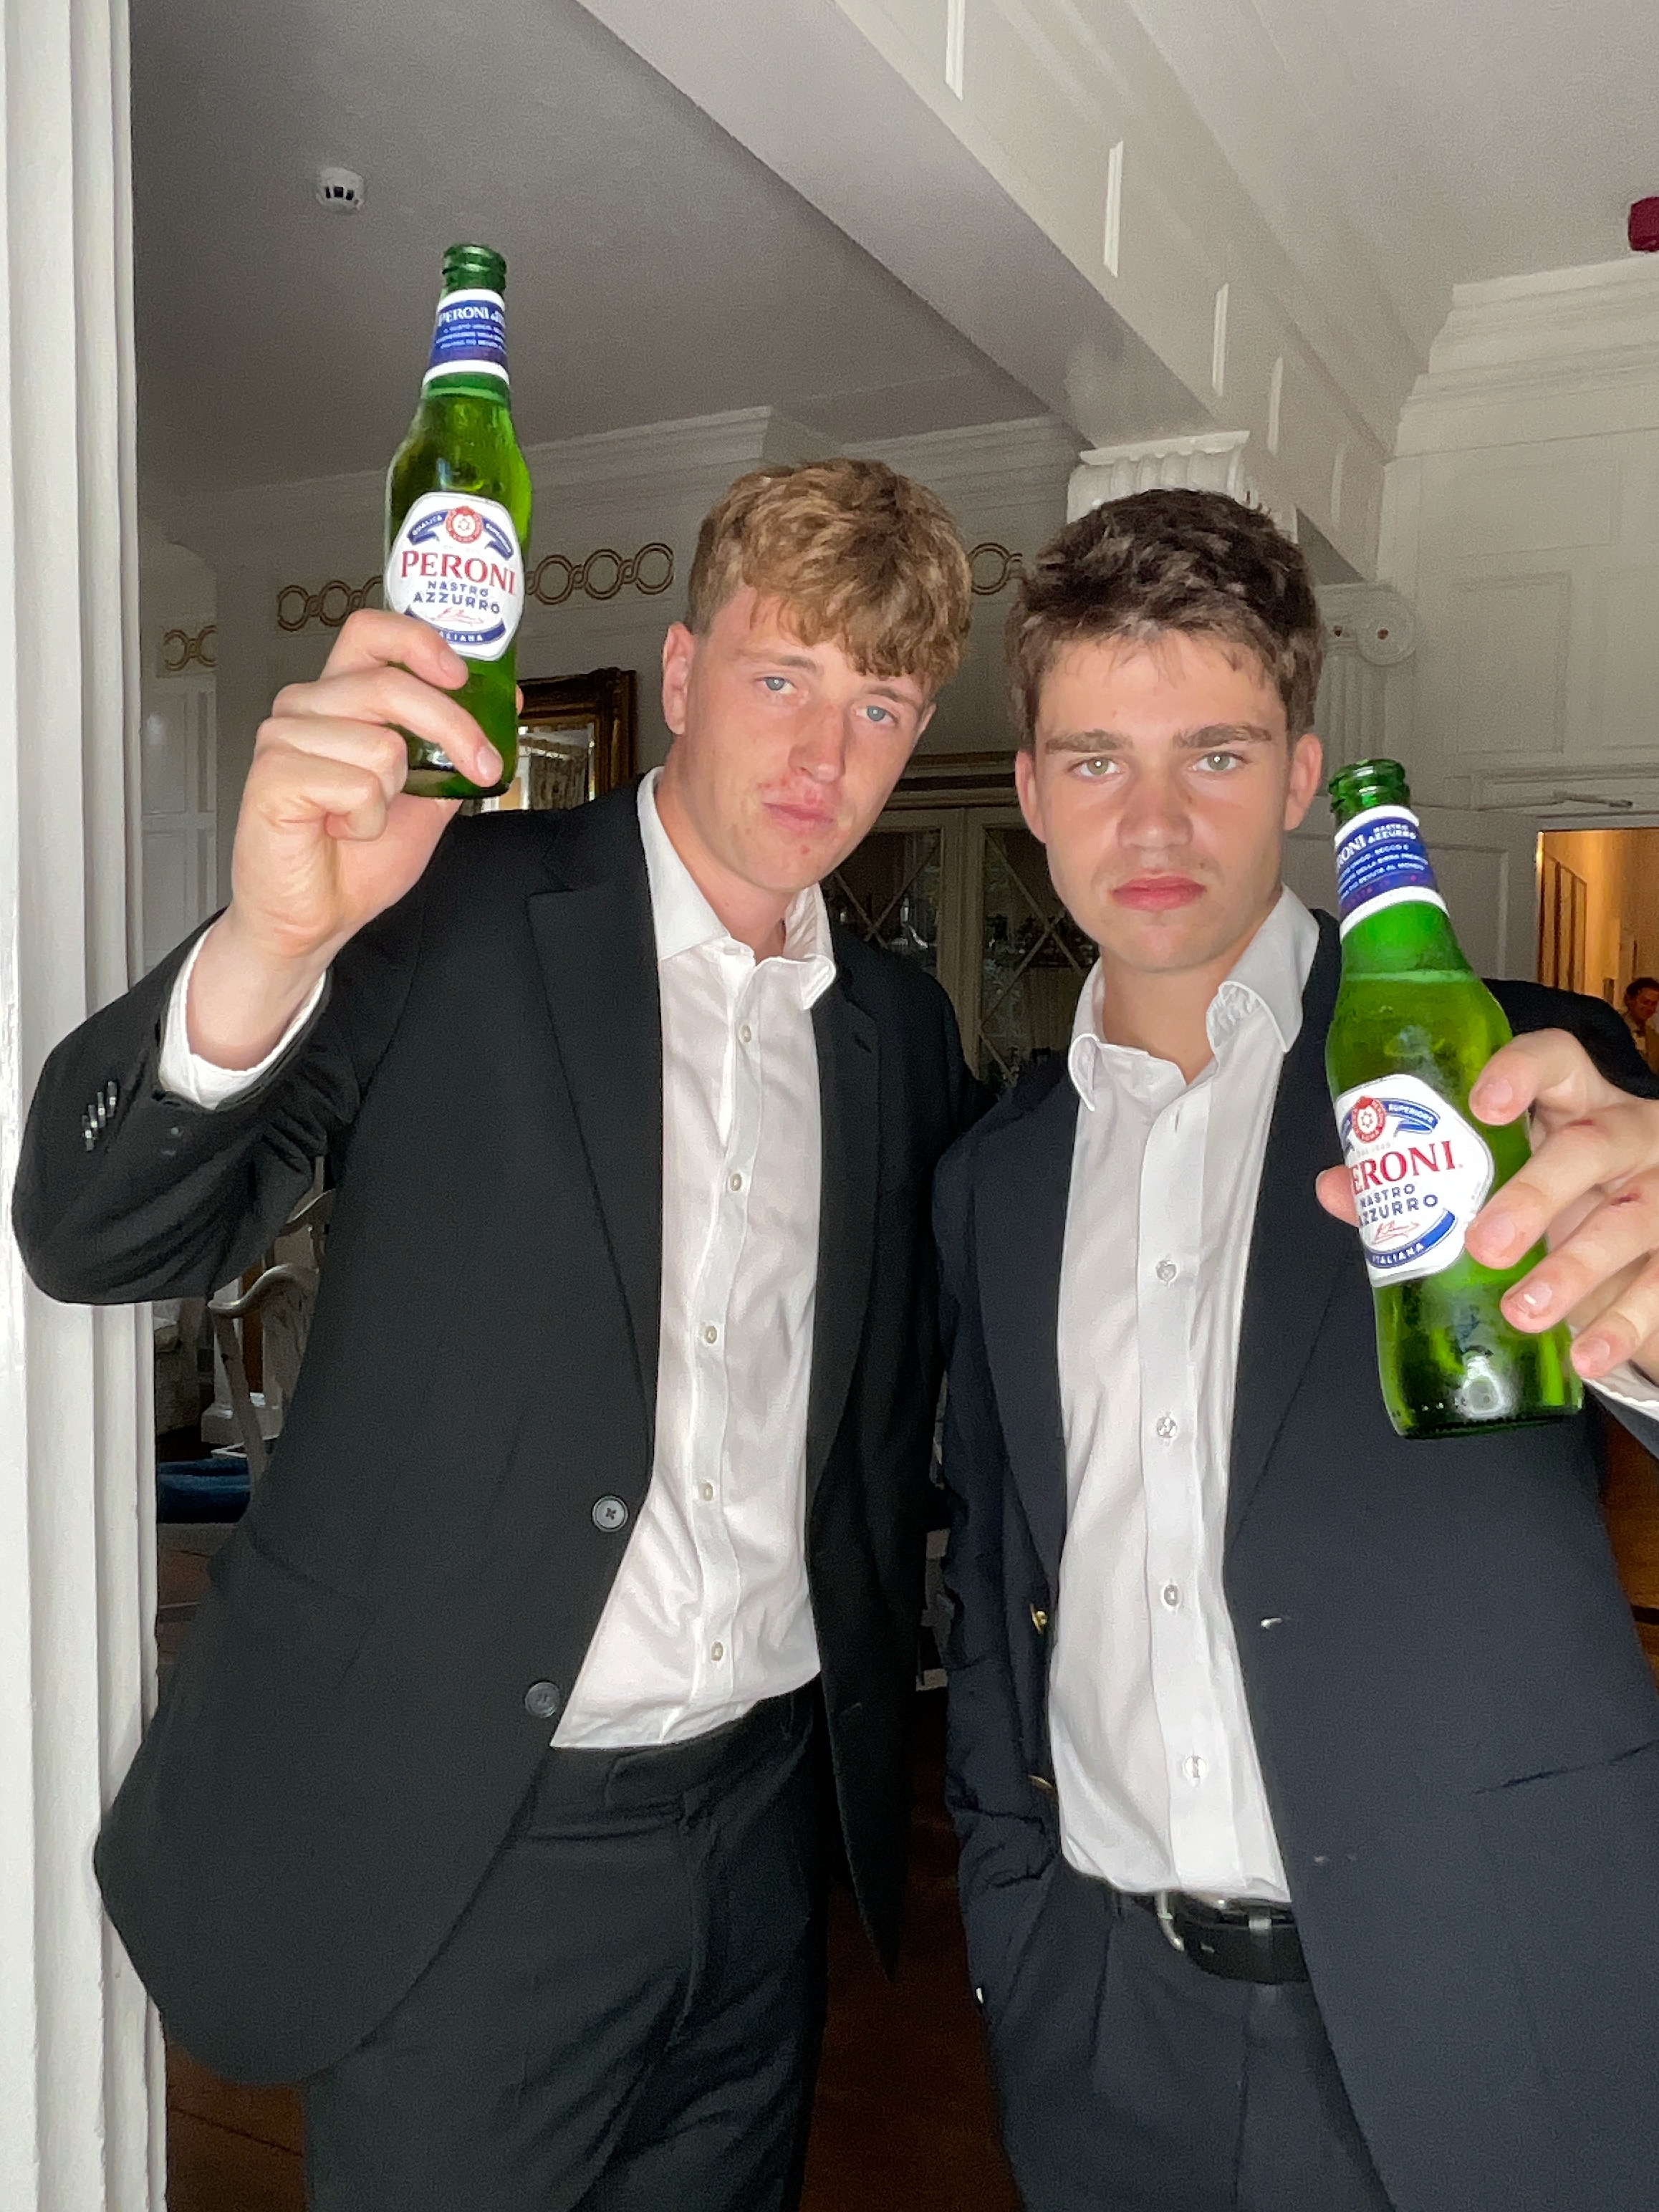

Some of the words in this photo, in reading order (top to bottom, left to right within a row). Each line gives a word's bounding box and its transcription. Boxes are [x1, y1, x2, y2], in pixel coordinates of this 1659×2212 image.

[438, 307, 489, 327] PERONI
[400, 549, 516, 595] PERONI
[428, 580, 489, 597] NASTRO
[413, 592, 500, 614] AZZURRO
[440, 630, 483, 642] LIANA
[1351, 1140, 1456, 1196] ERONI
[1360, 1183, 1415, 1208] NASTRO
[1372, 1242, 1424, 1264] ITALIANA
